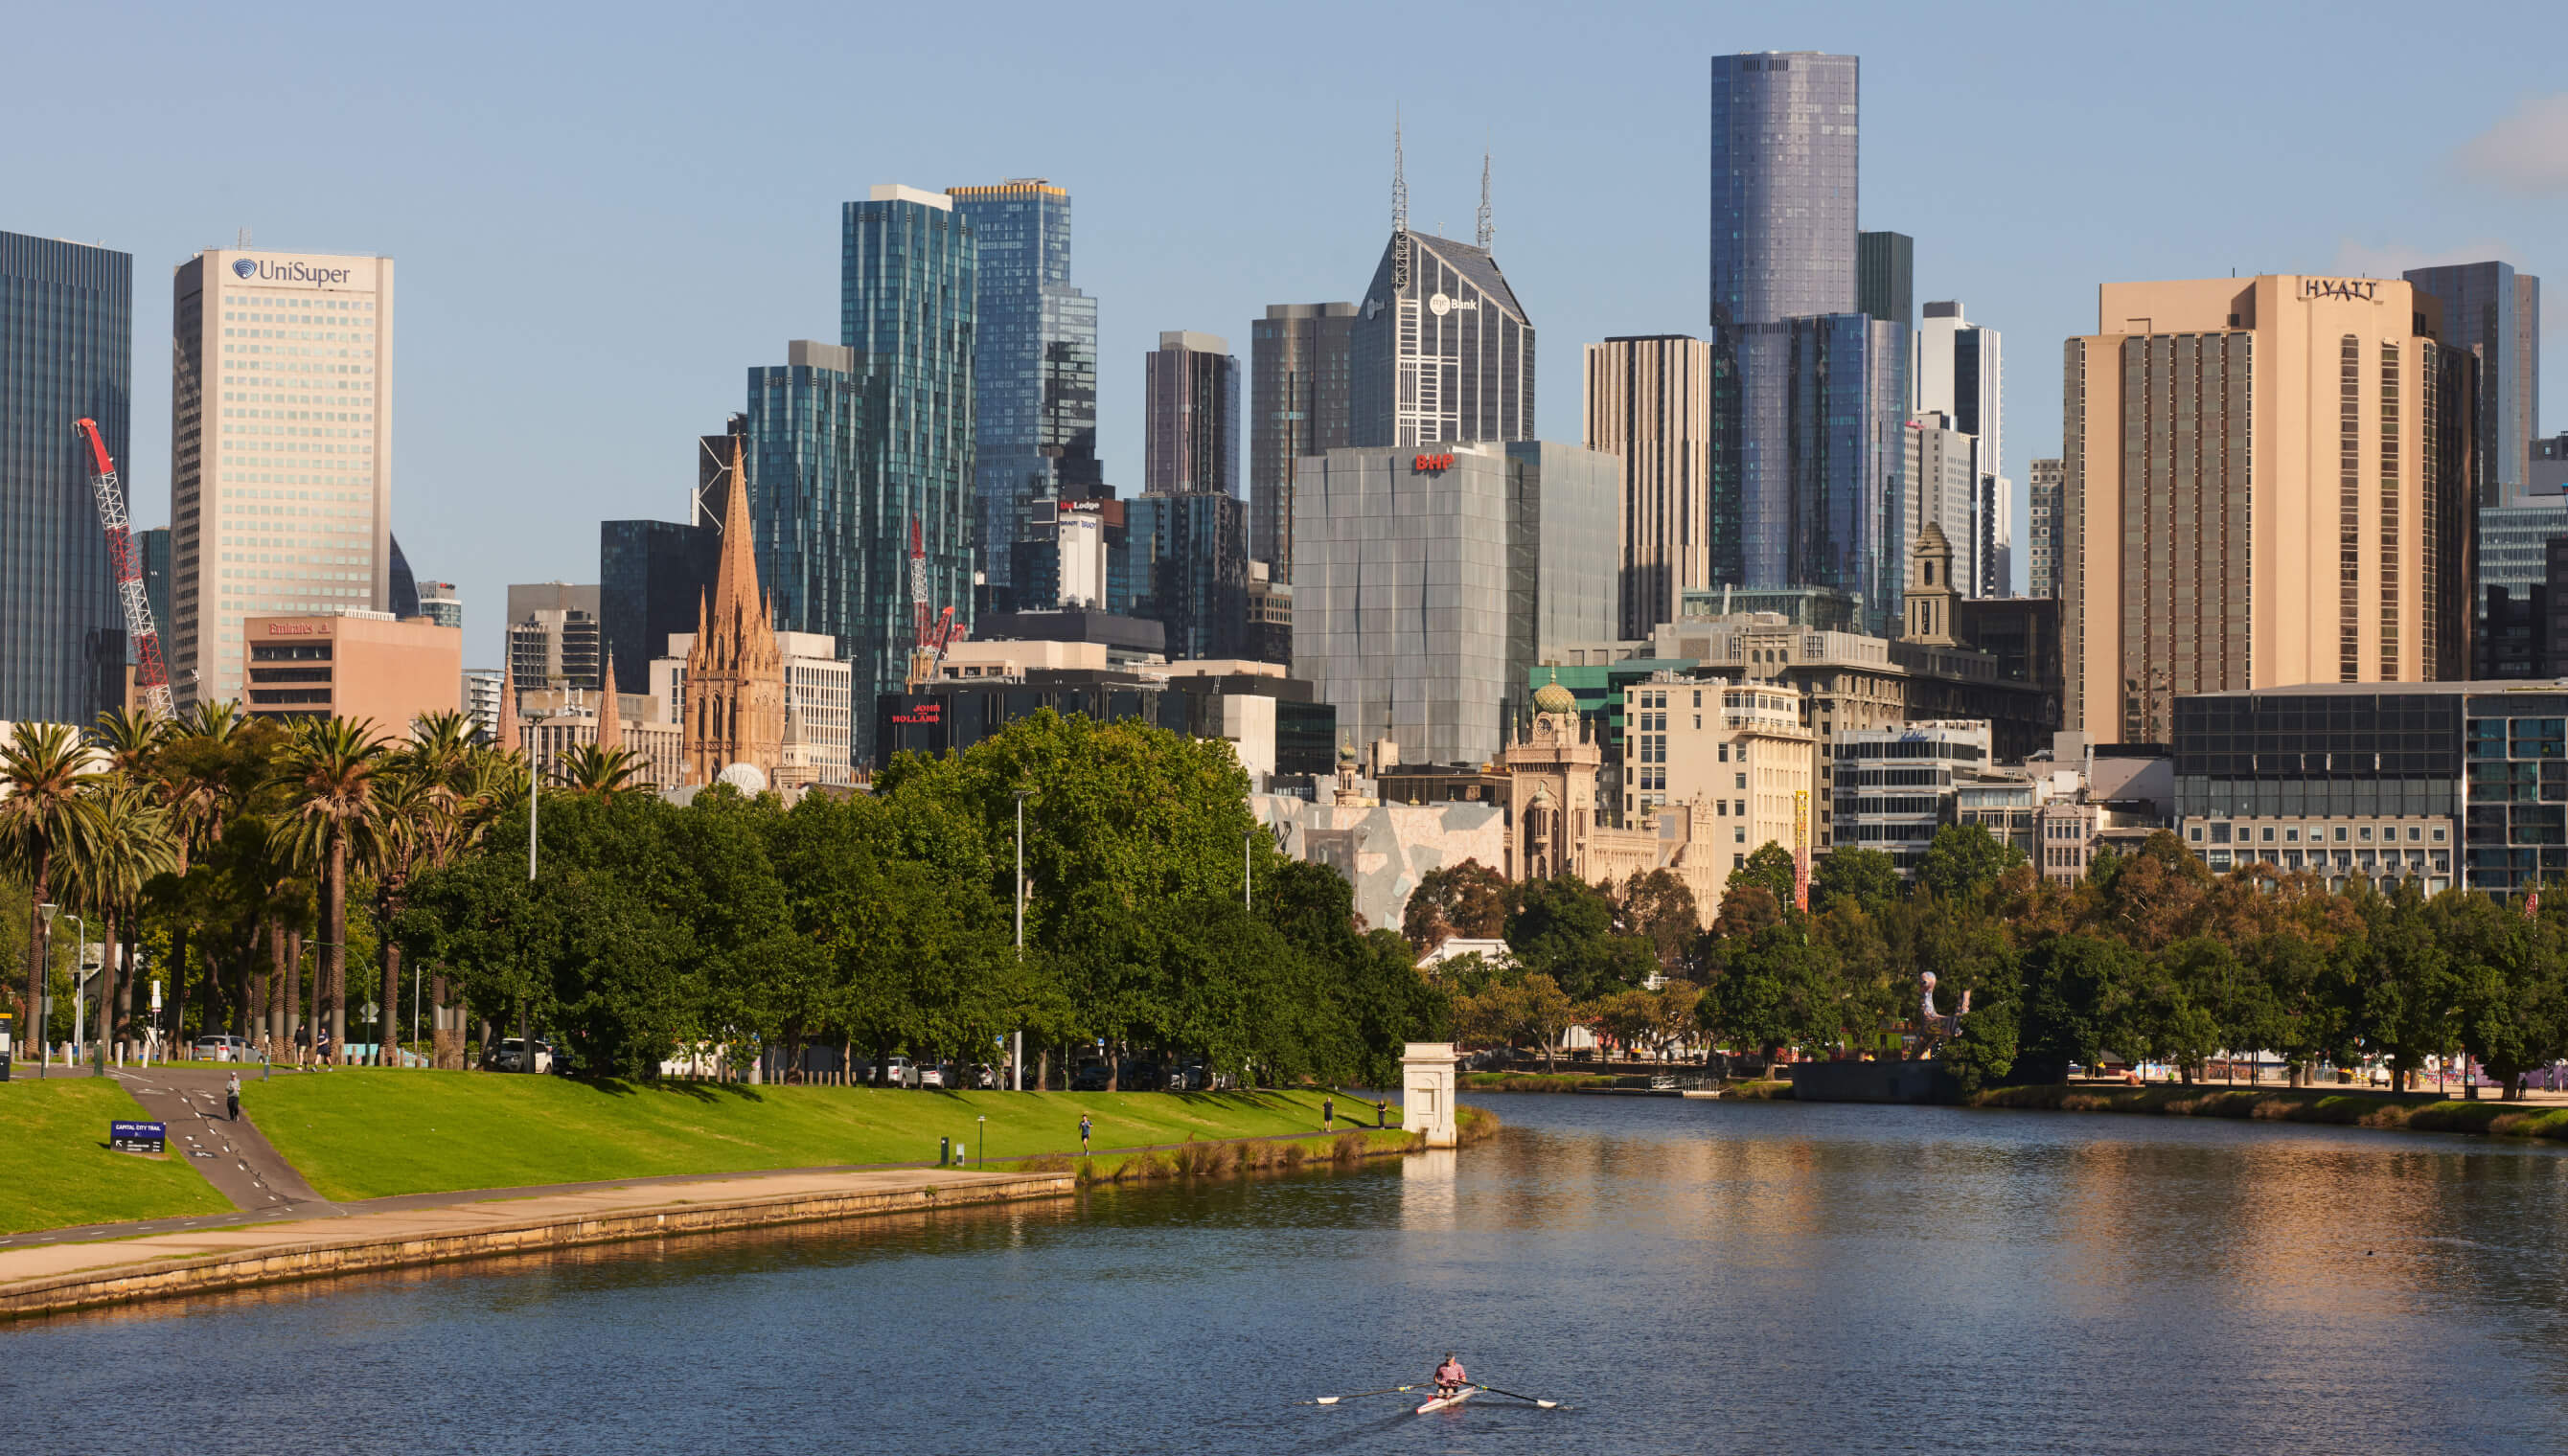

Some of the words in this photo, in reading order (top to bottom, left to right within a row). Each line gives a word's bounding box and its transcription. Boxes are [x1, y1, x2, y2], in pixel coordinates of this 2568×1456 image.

[260, 261, 351, 287] UniSuper
[2306, 280, 2376, 301] HYATT
[1451, 298, 1478, 310] Bank
[1416, 453, 1455, 470] BHP
[268, 622, 314, 635] Emirates
[892, 715, 940, 723] HOLLAND
